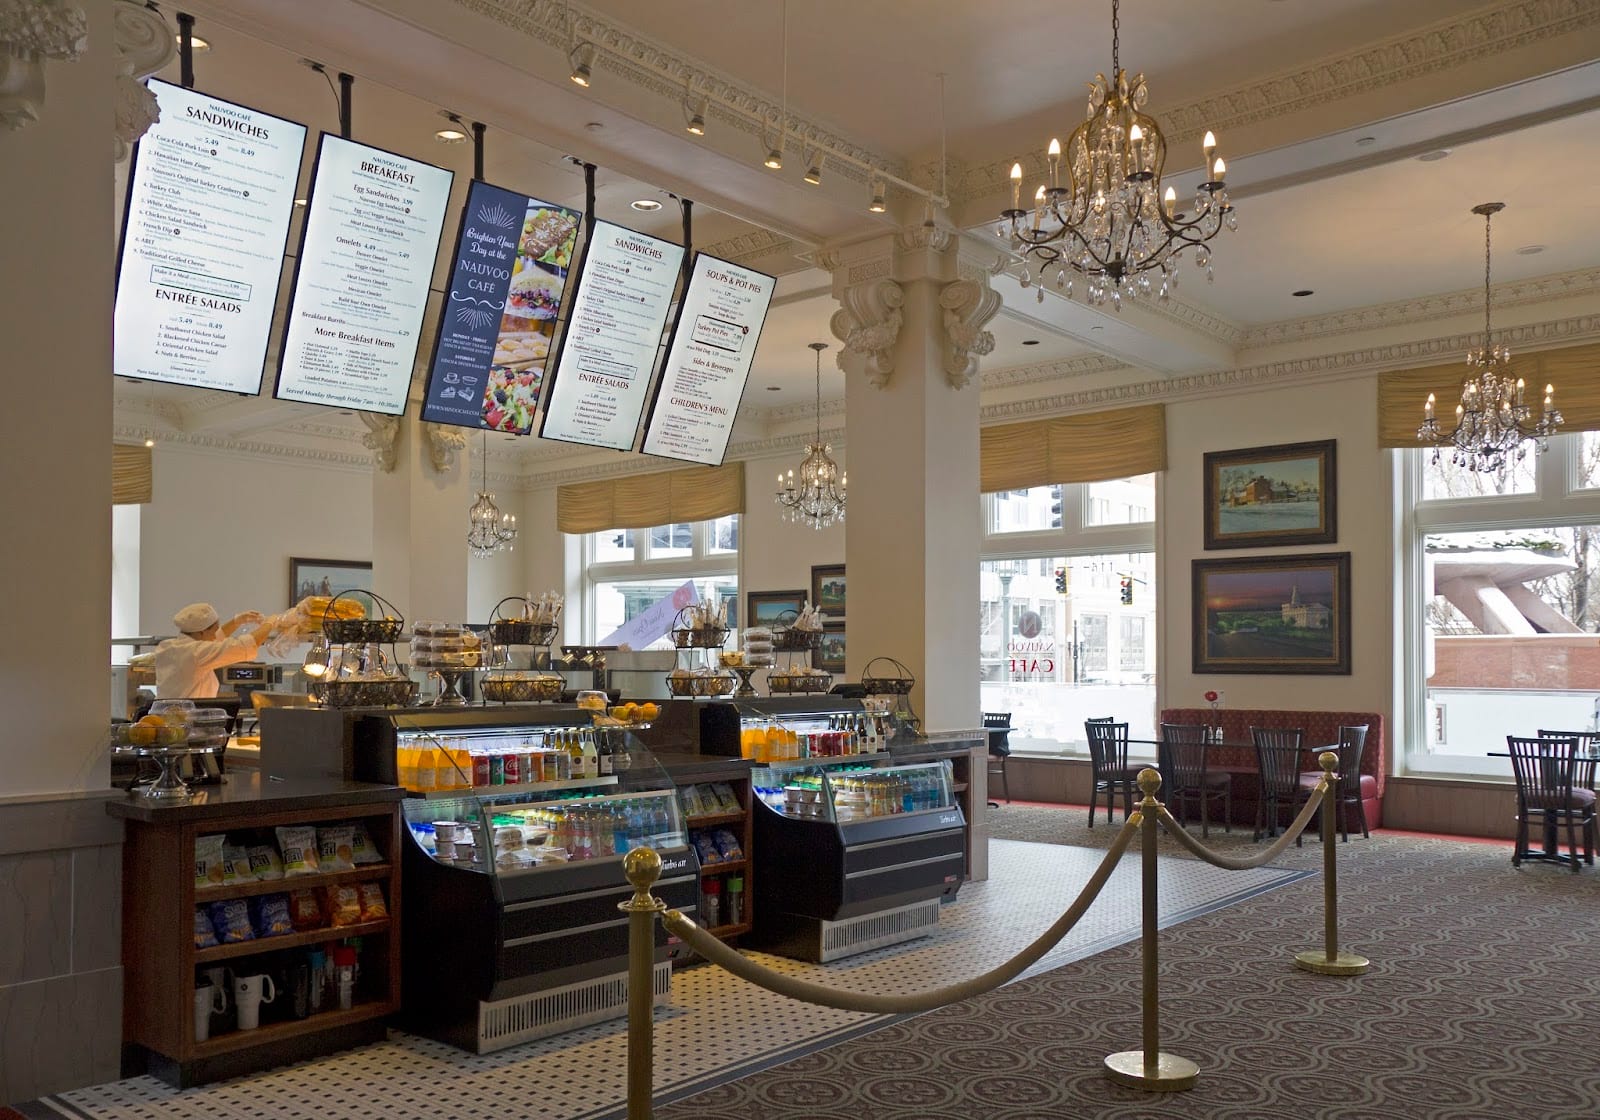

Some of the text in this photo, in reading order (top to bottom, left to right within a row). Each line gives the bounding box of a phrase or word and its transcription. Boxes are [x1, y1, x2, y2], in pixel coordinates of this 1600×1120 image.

[209, 104, 236, 116] NAUVOO
[186, 106, 268, 139] SANDWICHES
[205, 137, 218, 145] 5.49
[154, 150, 179, 161] Hawaiian
[180, 157, 192, 165] Ham
[240, 148, 254, 156] 8.49
[372, 156, 395, 166] NAUVOO
[360, 161, 414, 184] BREAKFAST
[149, 182, 166, 192] Turkey
[176, 173, 198, 183] Original
[199, 179, 215, 188] Turkey
[216, 184, 241, 195] Cranberry
[353, 184, 364, 193] Egg
[365, 187, 399, 202] Sandwiches
[384, 202, 404, 211] Sandwich
[143, 221, 161, 230] French
[144, 210, 166, 219] Chicken
[182, 219, 206, 229] Sandwich
[336, 236, 361, 247] Omelets
[496, 235, 514, 248] Your
[615, 238, 662, 258] SANDWICHES
[139, 248, 167, 259] Traditional
[469, 241, 487, 257] Day
[496, 250, 506, 259] the
[460, 259, 509, 280] NAUVOO
[467, 278, 495, 293] CAFÉ
[705, 269, 728, 282] SOUPS
[734, 278, 747, 288] POT
[748, 283, 761, 293] PIES
[155, 289, 197, 305] ENTRÉE
[200, 297, 240, 313] SALADS
[302, 311, 326, 320] Breakfast
[165, 325, 190, 333] Southwest
[697, 323, 711, 332] Turkey
[163, 333, 189, 342] Blackened
[314, 327, 336, 337] More
[338, 331, 372, 344] Breakfast
[374, 338, 394, 348] Items
[578, 373, 629, 389] ENTRÉE SALADS
[304, 390, 325, 398] Monday
[670, 397, 708, 411] CHILDREN'S
[708, 405, 728, 415] MENU
[662, 858, 686, 870] Turbo air
